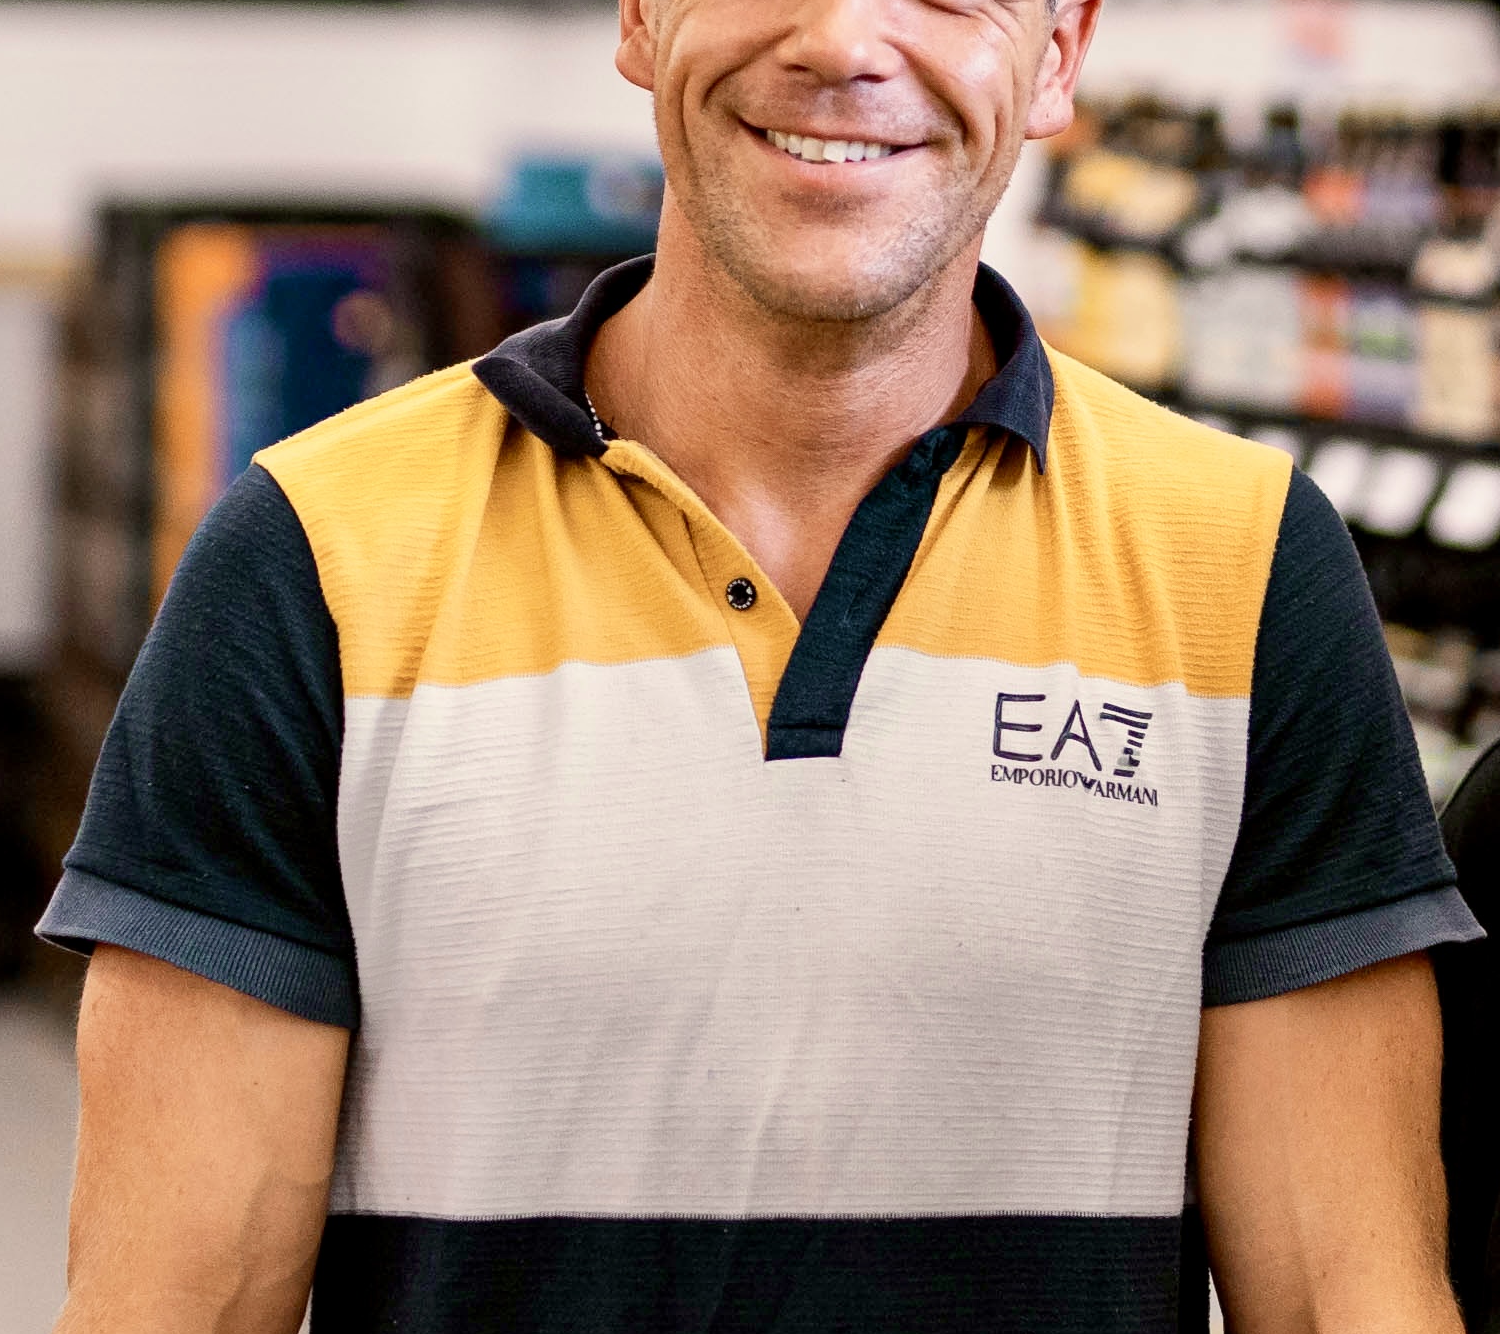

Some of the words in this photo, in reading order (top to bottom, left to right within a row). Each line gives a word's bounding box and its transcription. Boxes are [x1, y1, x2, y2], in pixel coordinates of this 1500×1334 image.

[992, 692, 1153, 778] EA7
[990, 764, 1081, 788] EMPORIO
[1093, 780, 1159, 807] ARMANI
